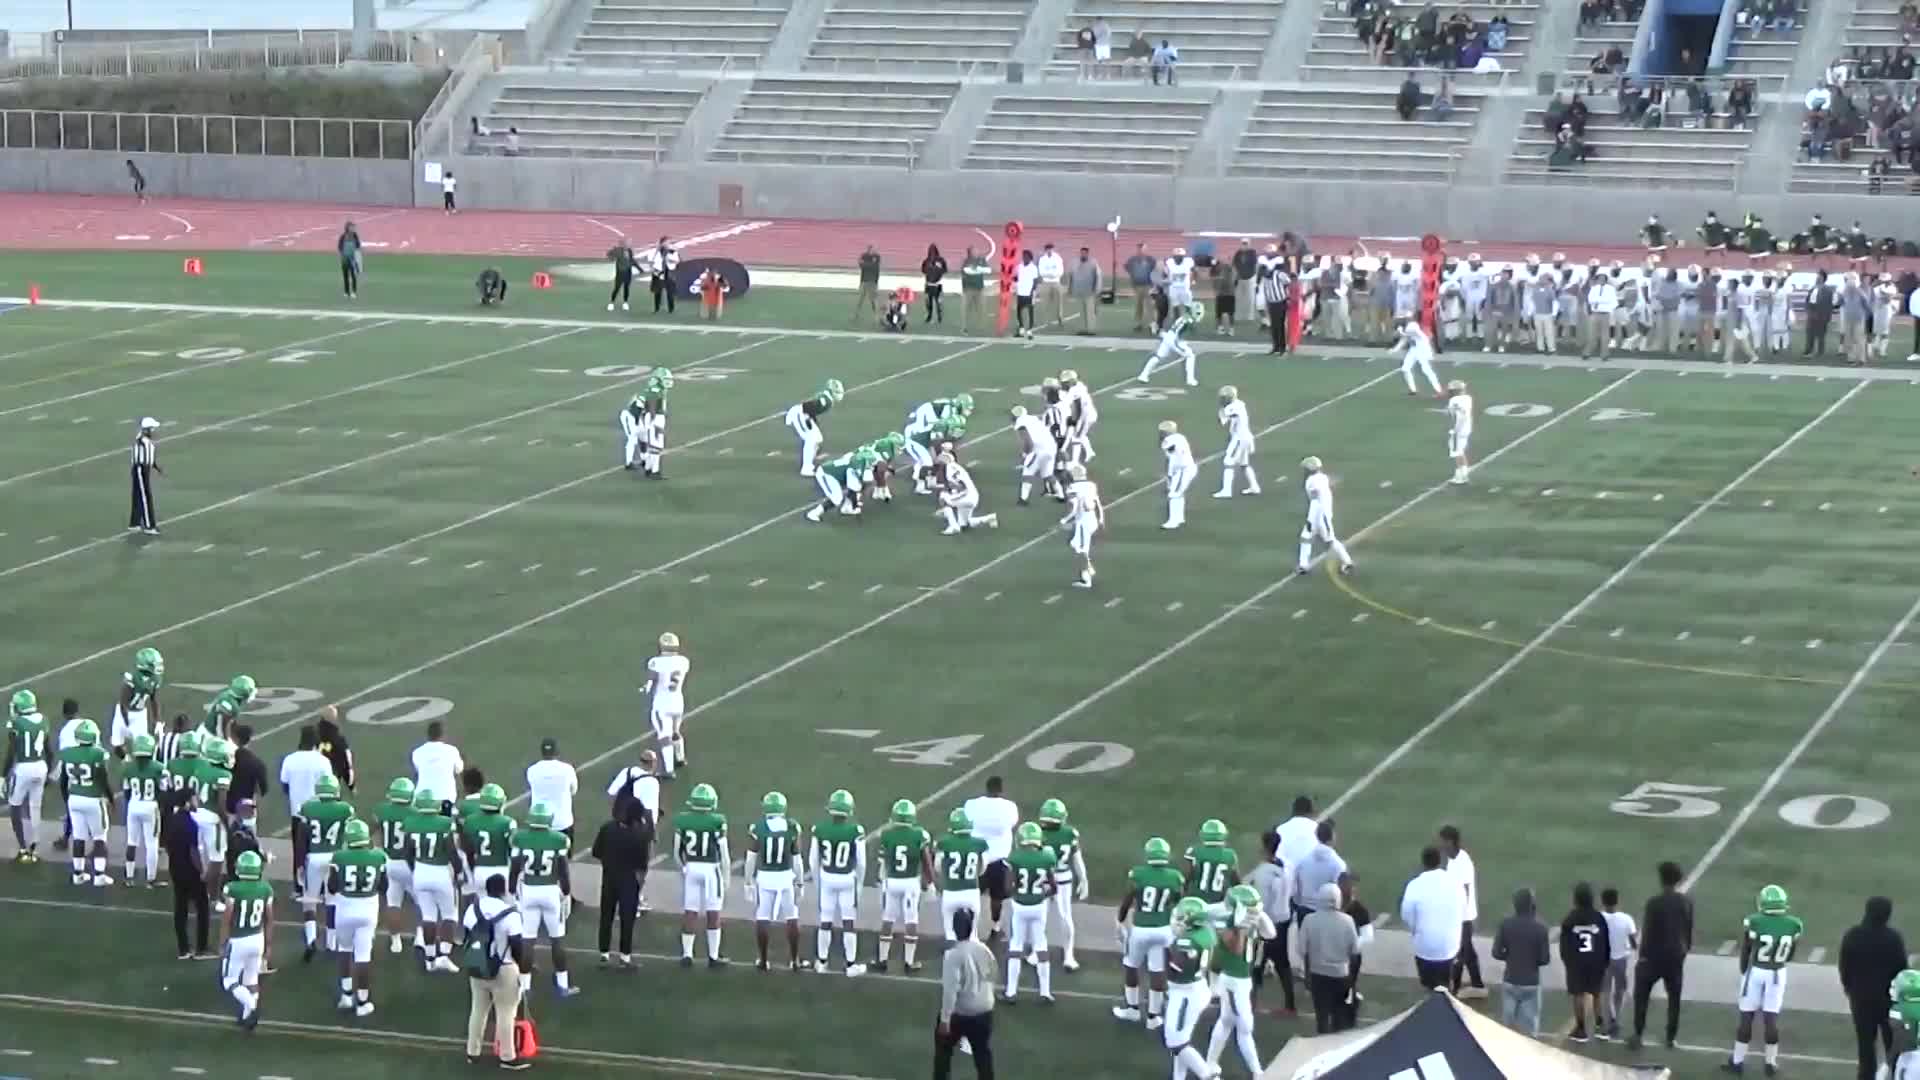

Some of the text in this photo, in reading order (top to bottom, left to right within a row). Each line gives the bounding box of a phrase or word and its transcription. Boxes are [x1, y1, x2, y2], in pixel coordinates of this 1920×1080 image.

[24, 731, 45, 758] 14
[873, 733, 1136, 774] 40
[1610, 782, 1892, 830] 50
[311, 819, 341, 846] 34
[410, 832, 438, 859] 17
[478, 830, 491, 857] 2
[685, 830, 709, 857] 21
[522, 850, 556, 877] 25
[766, 836, 785, 864] 11
[821, 840, 851, 869] 30
[895, 846, 908, 872] 5
[344, 866, 377, 892] 53
[949, 852, 979, 880] 28
[1200, 861, 1229, 892] 16
[1017, 868, 1047, 895] 32
[1141, 886, 1170, 913] 91
[238, 898, 265, 929] 18
[1579, 933, 1592, 953] 3
[1757, 934, 1793, 963] 20
